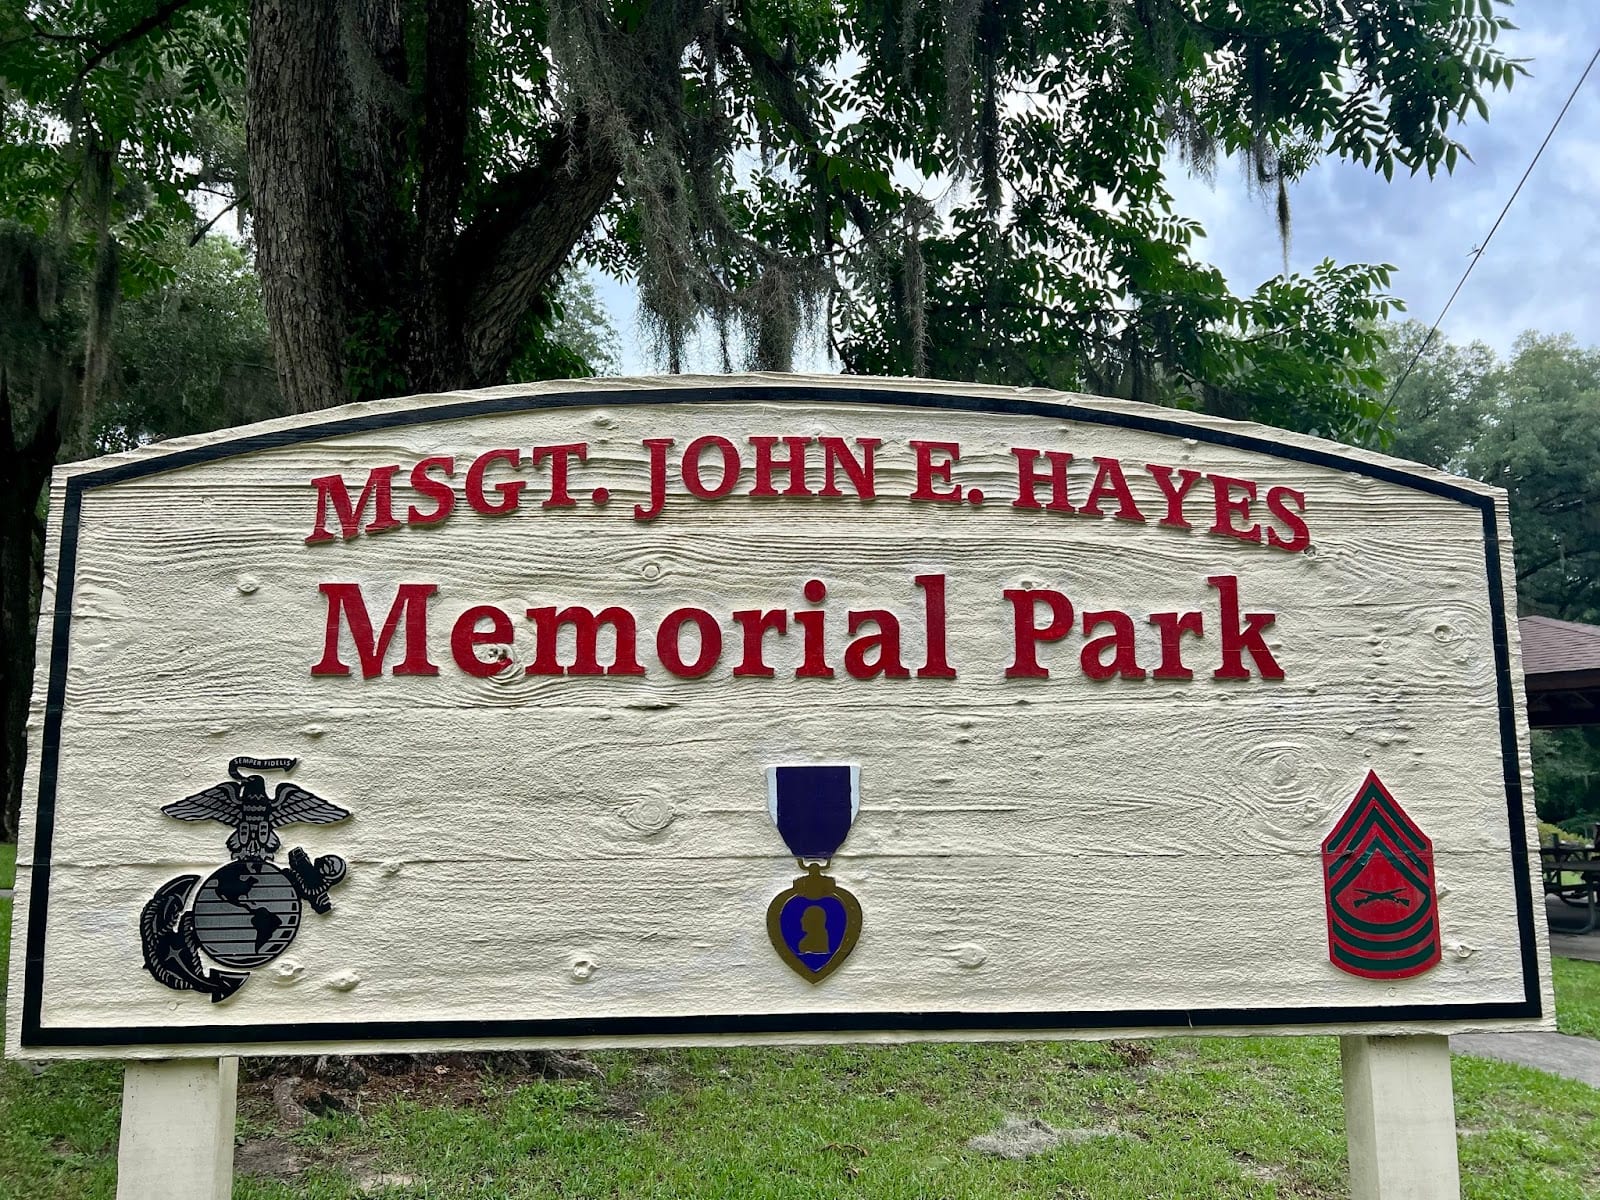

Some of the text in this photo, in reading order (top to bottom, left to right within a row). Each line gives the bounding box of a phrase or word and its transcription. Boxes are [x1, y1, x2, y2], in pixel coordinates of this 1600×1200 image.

[304, 435, 1311, 552] MSGT. JOHN E. HAYES
[311, 573, 1285, 680] Memorial Park
[234, 758, 262, 766] SEMPER
